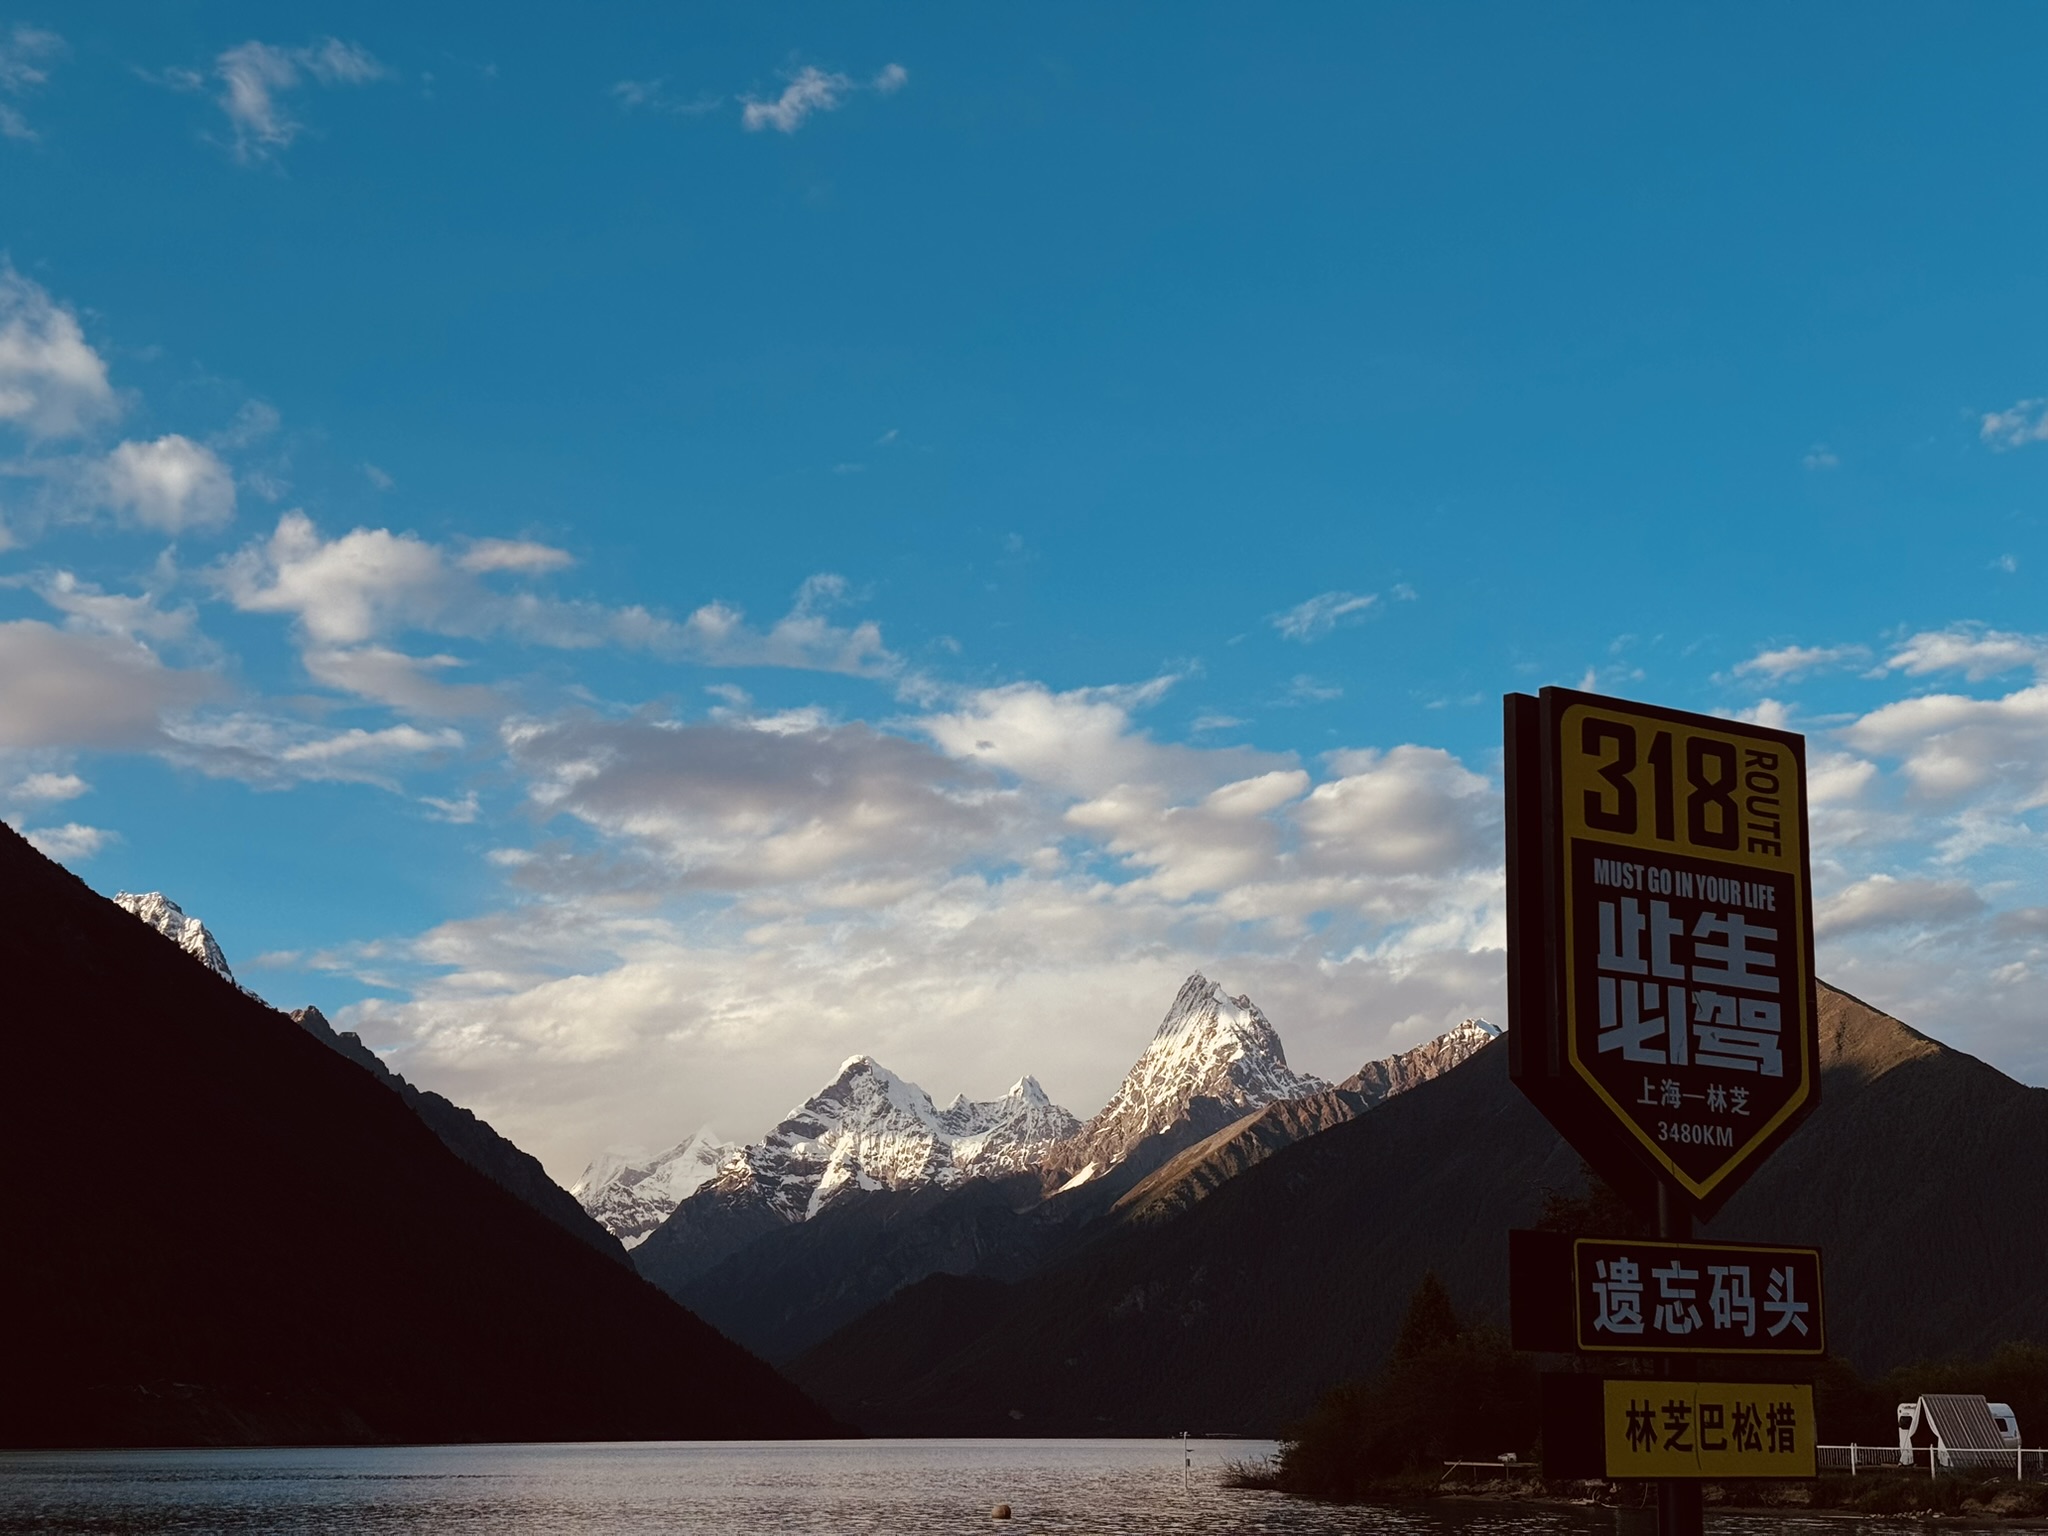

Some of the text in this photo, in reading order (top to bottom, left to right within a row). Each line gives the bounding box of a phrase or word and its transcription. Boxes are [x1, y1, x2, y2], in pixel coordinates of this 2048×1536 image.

[1582, 717, 1740, 851] 318
[1745, 749, 1782, 857] ROUTE
[1593, 858, 1777, 912] MUST GO IN YOUR LIFE
[1597, 896, 1781, 994] 此生
[1598, 976, 1784, 1078] 必驾
[1657, 1121, 1734, 1148] 3480KM
[1592, 1256, 1810, 1338] 遗忘码头
[1625, 1398, 1796, 1454] 林芝巴松措
